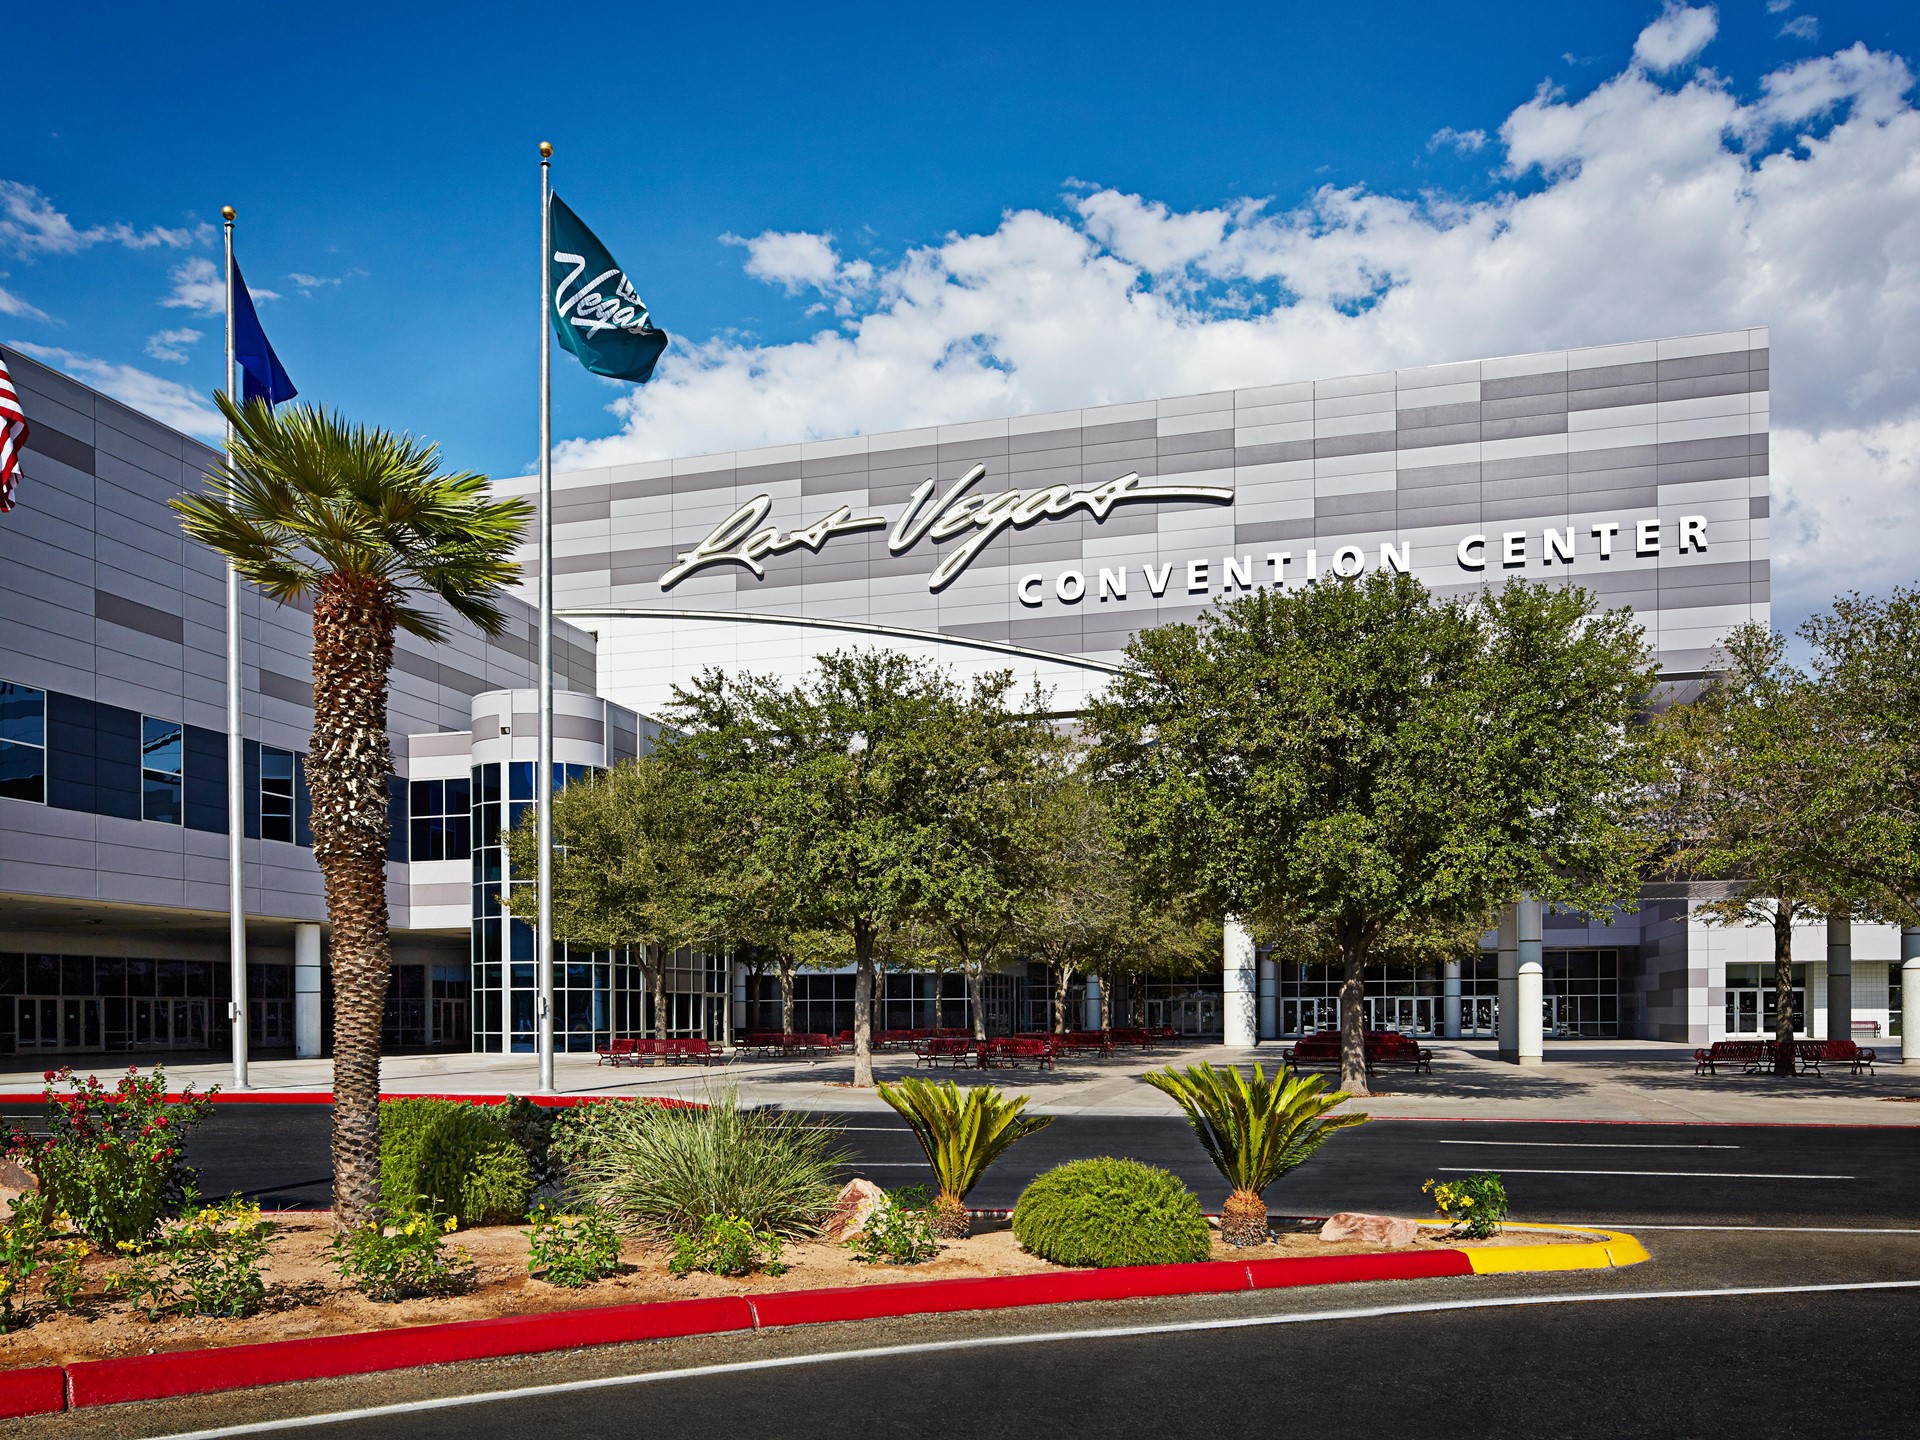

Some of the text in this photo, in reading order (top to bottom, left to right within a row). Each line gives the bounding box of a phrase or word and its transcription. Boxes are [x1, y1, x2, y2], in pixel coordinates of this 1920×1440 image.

[554, 251, 653, 339] Vegas
[658, 462, 1235, 590] Las Vegas
[1017, 515, 1710, 605] CONVENTION CENTER
